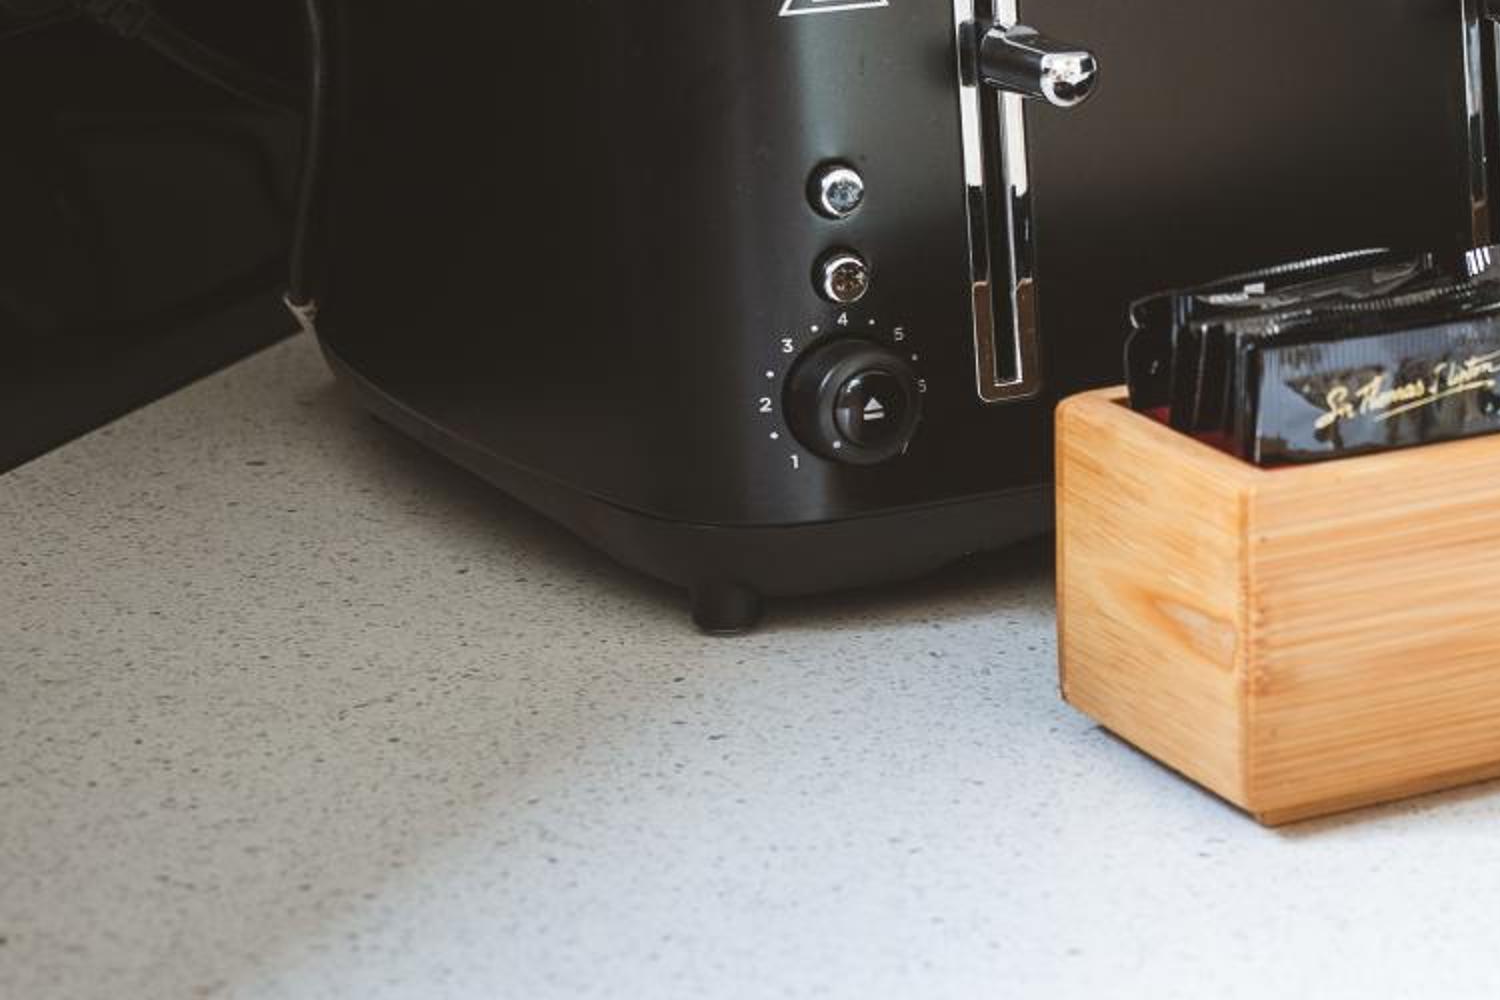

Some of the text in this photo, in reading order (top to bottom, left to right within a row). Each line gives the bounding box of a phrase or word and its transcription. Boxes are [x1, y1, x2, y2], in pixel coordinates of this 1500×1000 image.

[836, 312, 849, 327] 4
[893, 327, 905, 341] 5
[781, 338, 794, 353] 3
[759, 397, 773, 413] 2
[790, 454, 800, 469] 1
